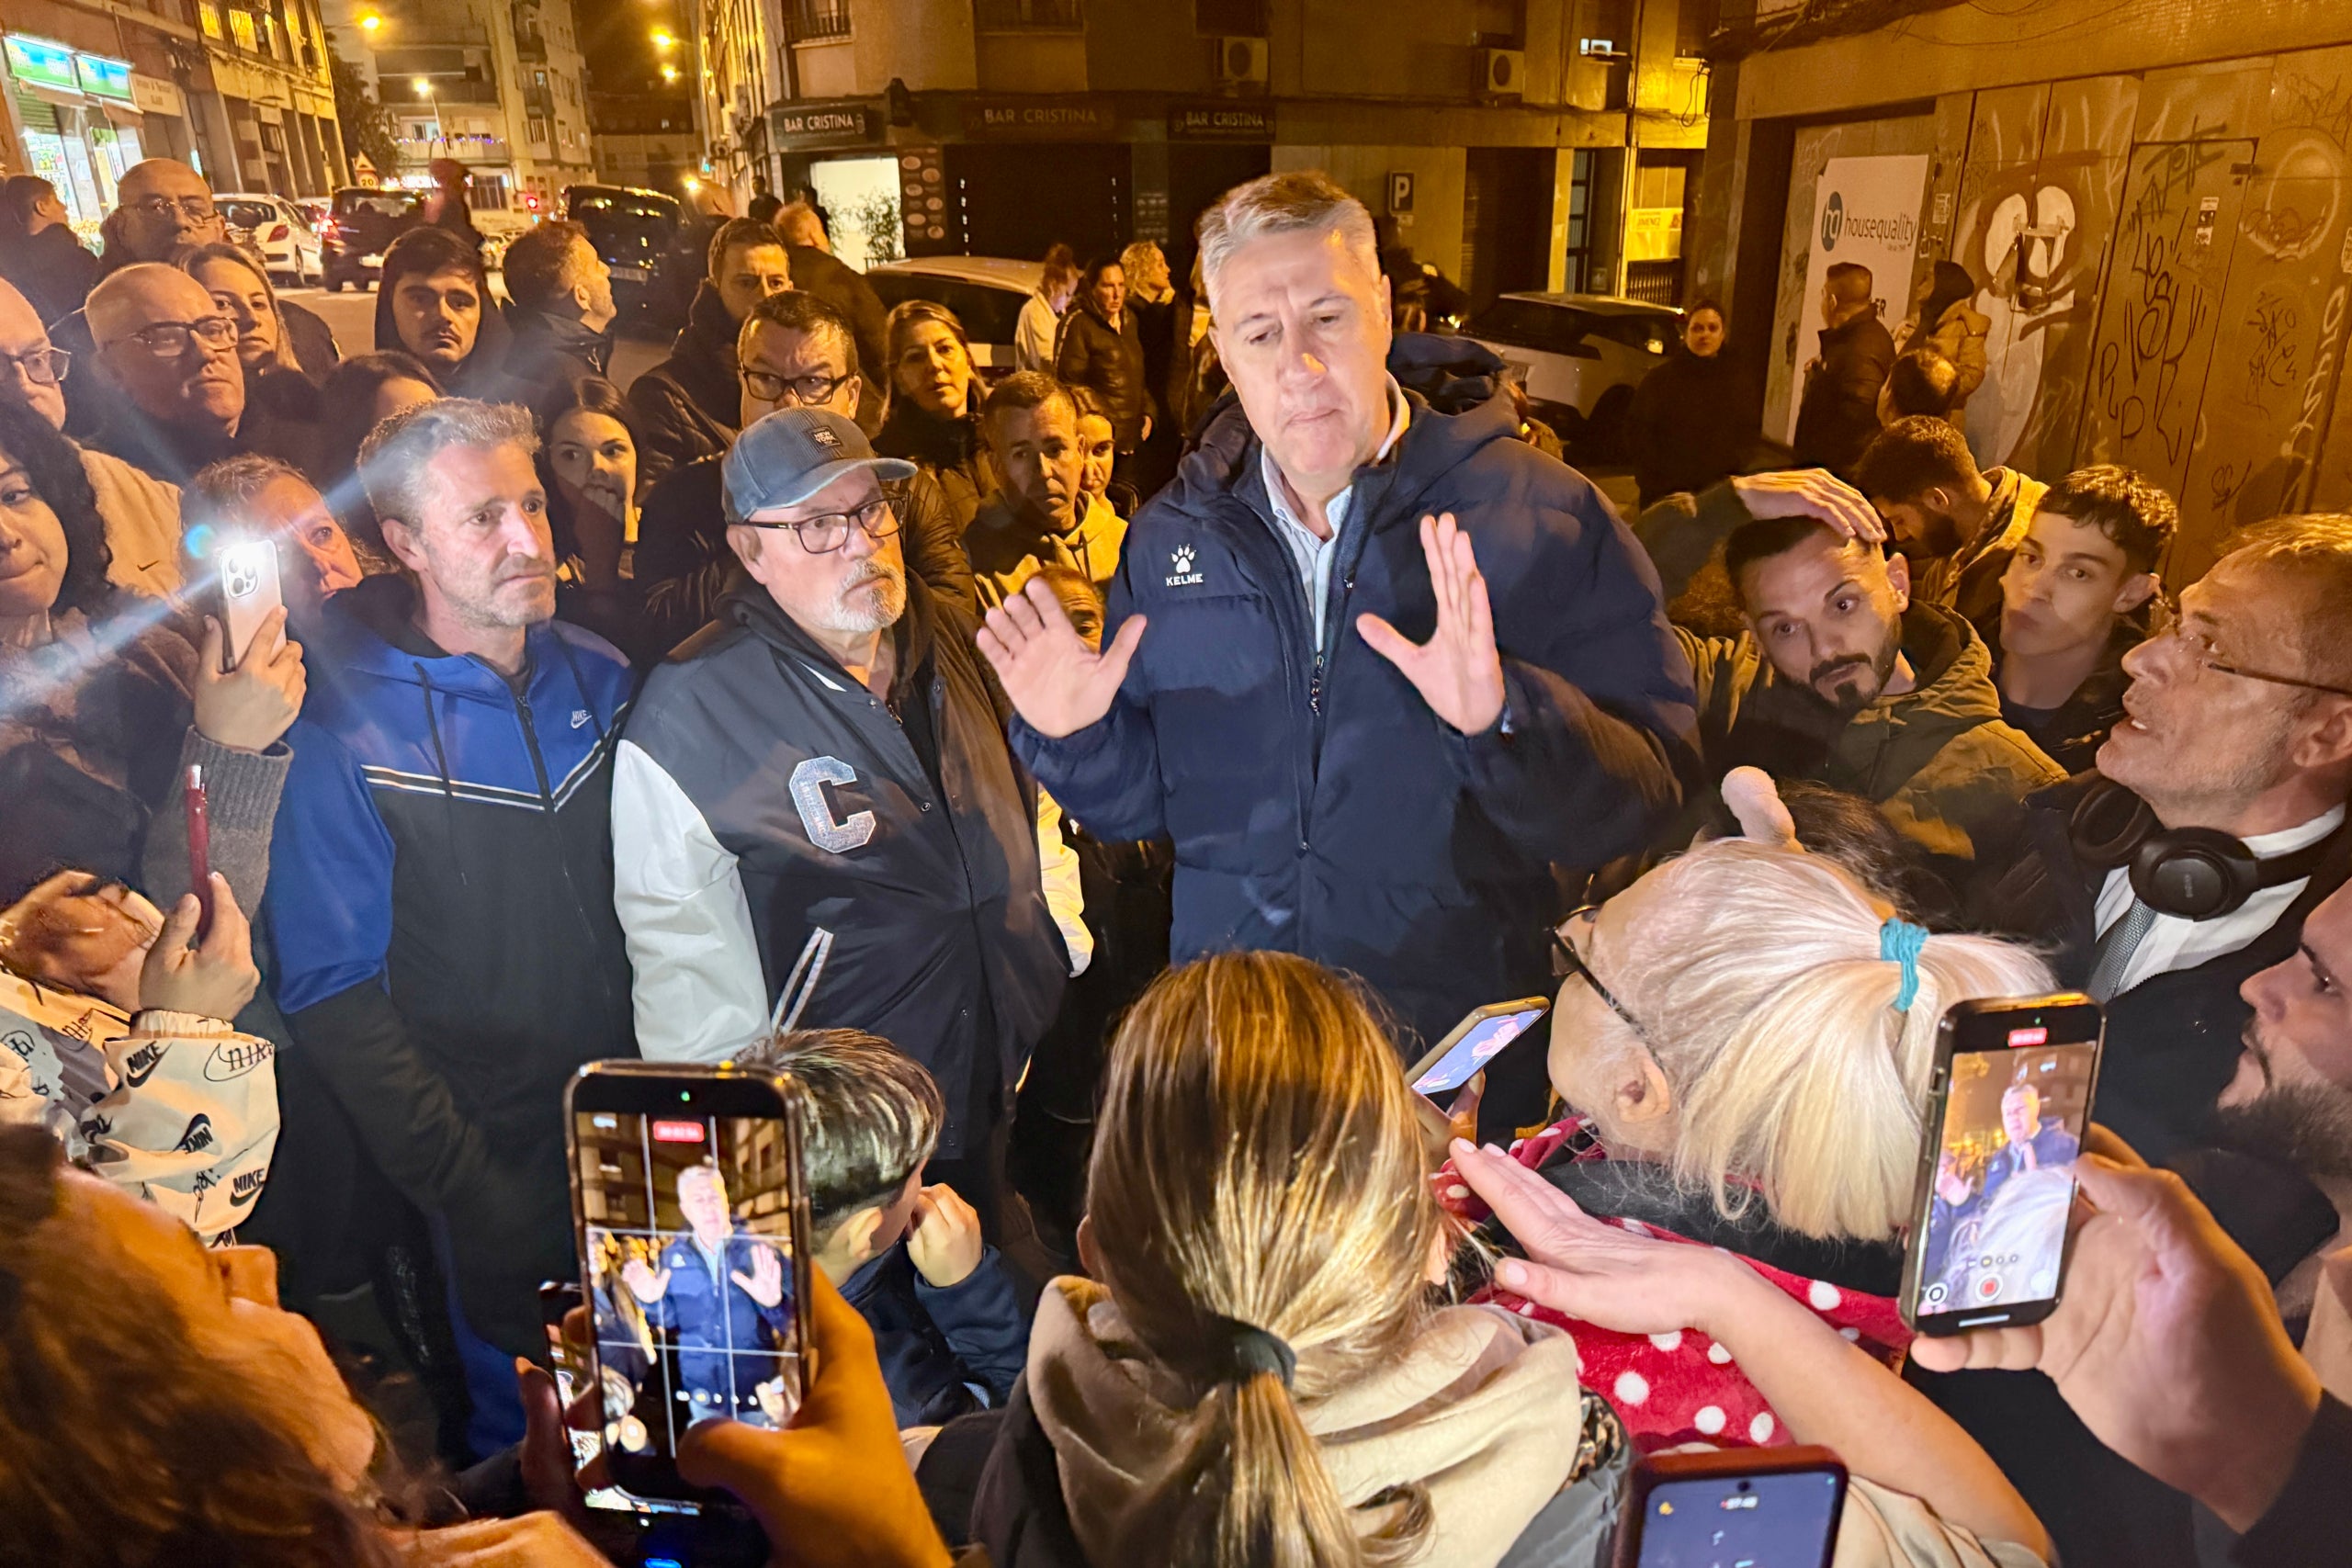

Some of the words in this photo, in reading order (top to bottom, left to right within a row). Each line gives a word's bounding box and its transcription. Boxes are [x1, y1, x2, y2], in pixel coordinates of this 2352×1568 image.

[784, 117, 804, 133] BAR
[807, 113, 854, 131] CRISTINA
[984, 108, 1015, 124] BAR
[1023, 108, 1097, 123] CRISTINA
[1186, 111, 1209, 126] BAR
[1213, 112, 1264, 127] CRISTINA
[1394, 175, 1410, 209] P
[1845, 210, 1917, 247] housequality
[1166, 573, 1204, 587] KELME
[789, 755, 876, 854] C
[126, 1040, 161, 1073] NIKE
[232, 1168, 266, 1193] NIKE
